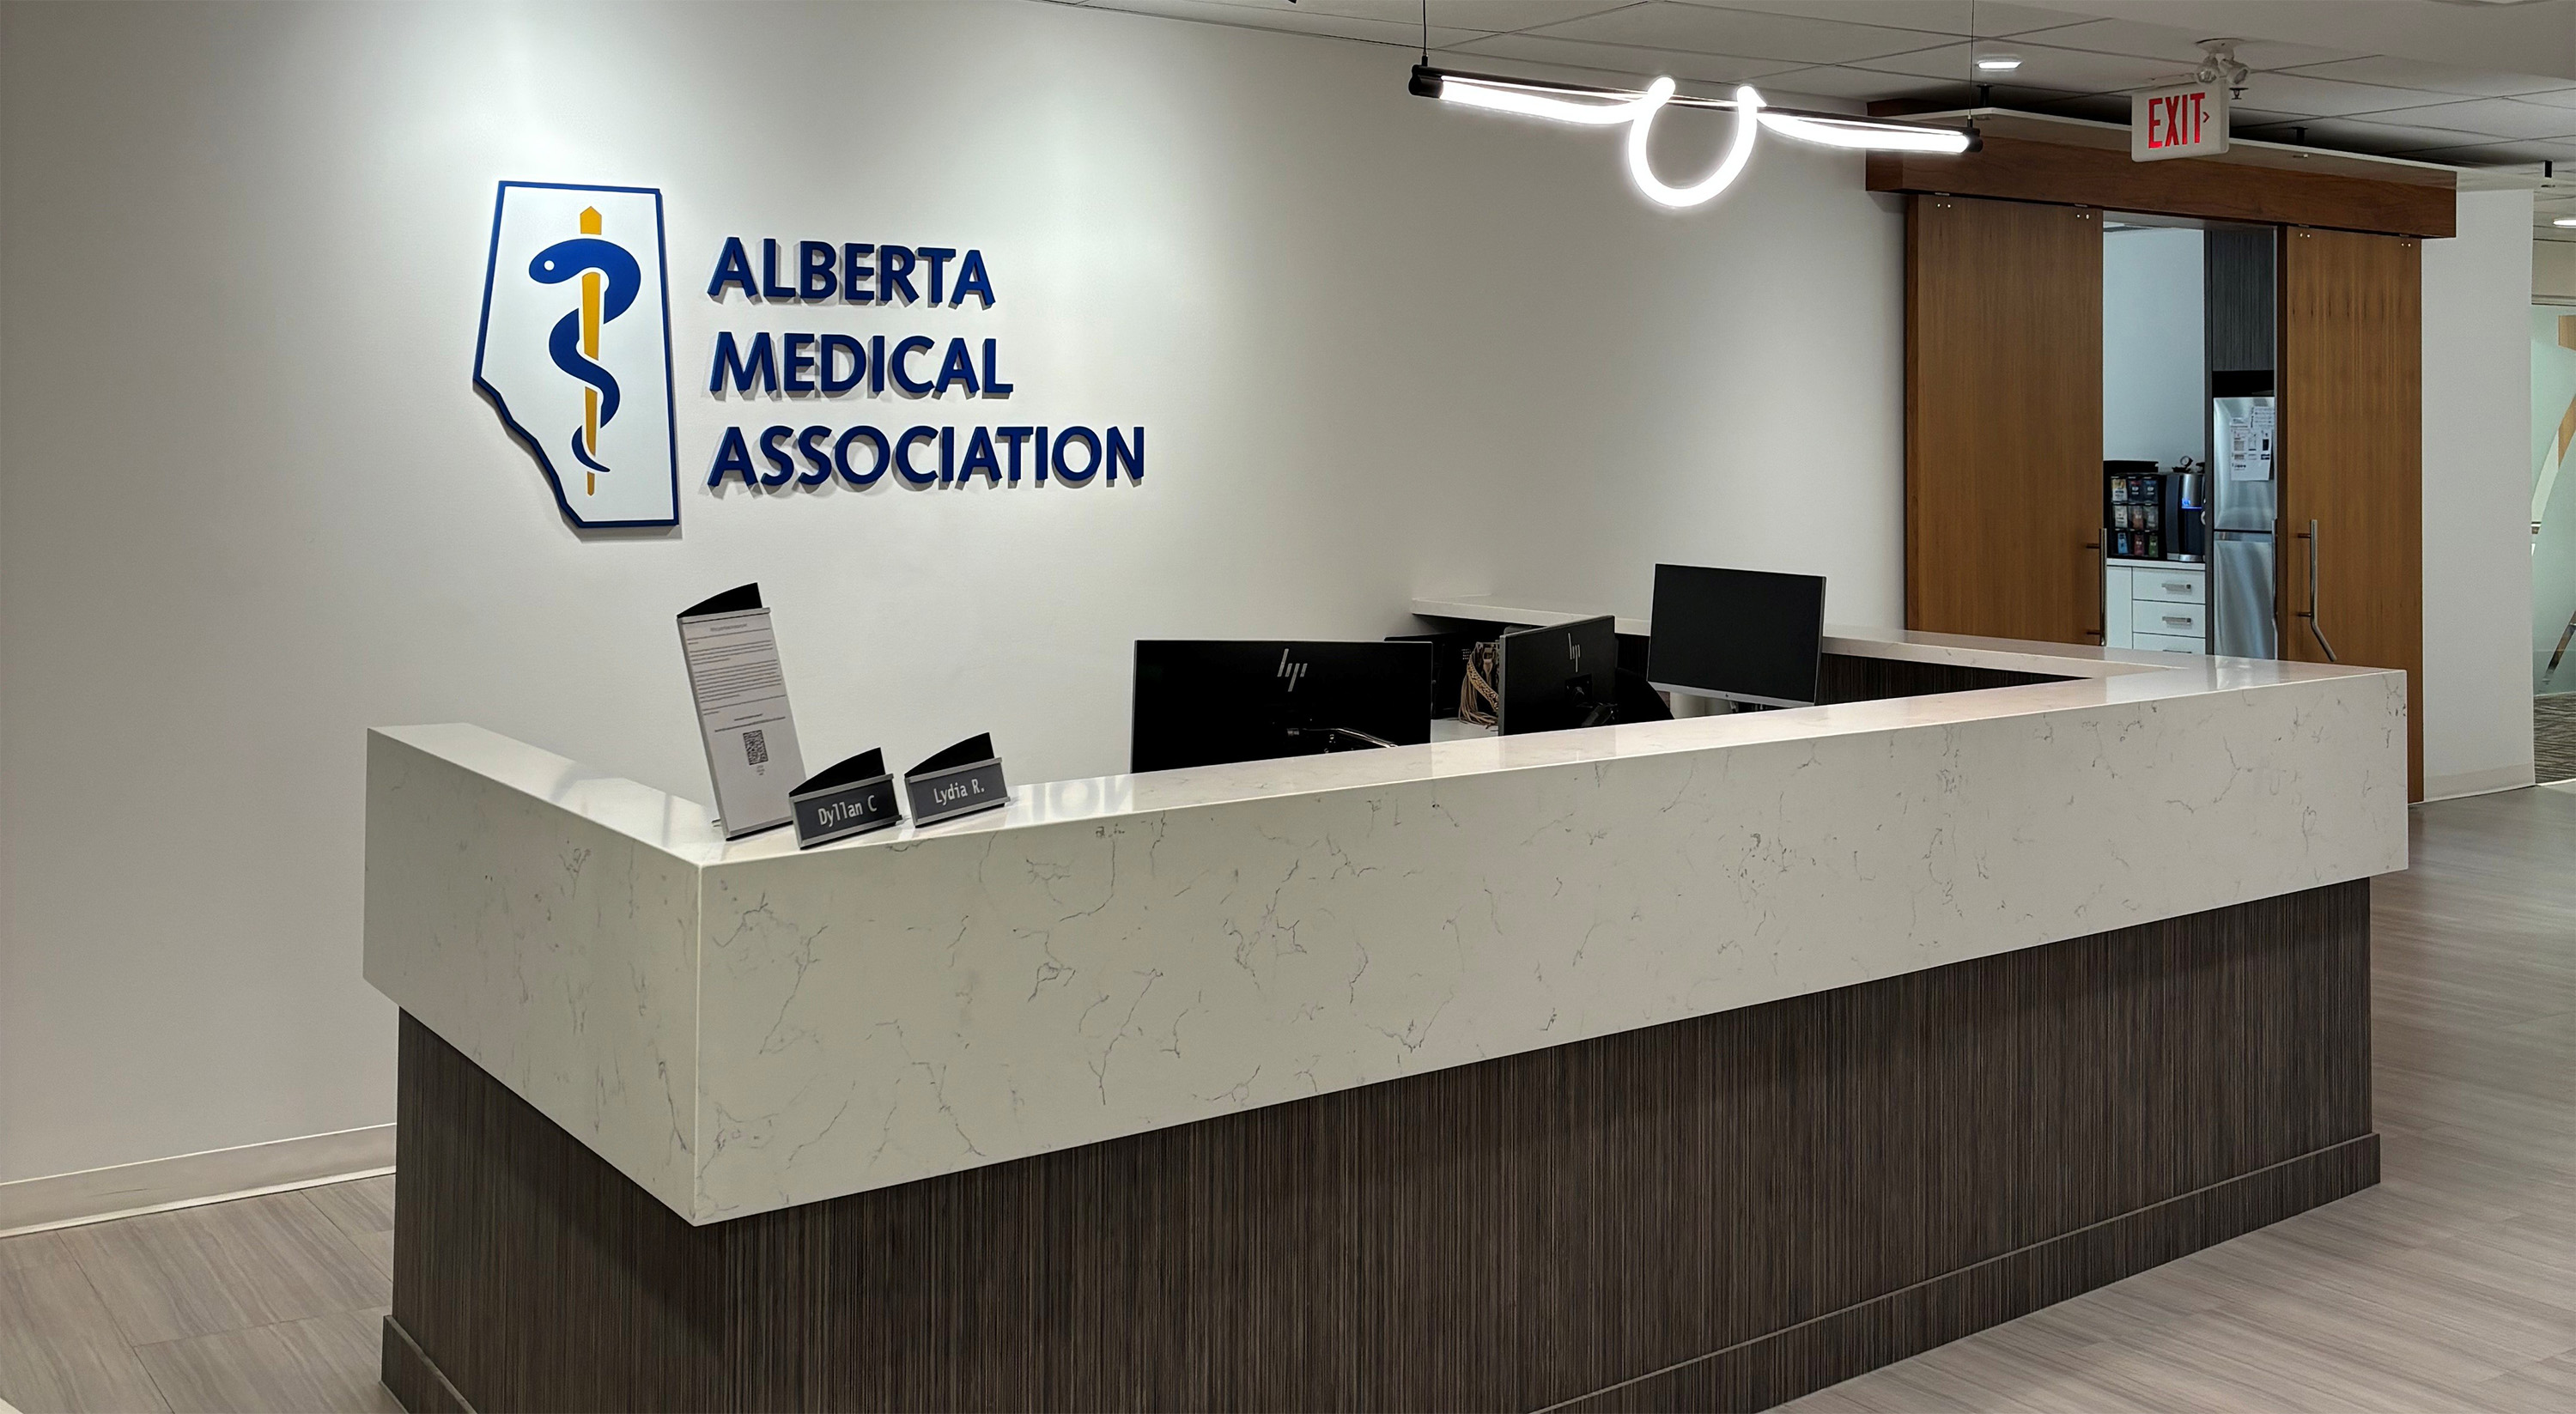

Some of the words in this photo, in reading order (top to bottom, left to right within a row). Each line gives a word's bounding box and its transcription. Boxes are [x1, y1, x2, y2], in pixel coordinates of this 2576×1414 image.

[2148, 93, 2205, 149] EXIT
[707, 236, 997, 306] ALBERTA
[708, 331, 1014, 396] MEDICAL
[707, 425, 1145, 488] ASSOCIATION
[1277, 648, 1308, 692] hp
[1568, 633, 1581, 673] hp
[817, 801, 863, 828] Dyllan
[867, 794, 878, 812] C
[933, 782, 969, 806] Lydia
[971, 778, 985, 794] R.
